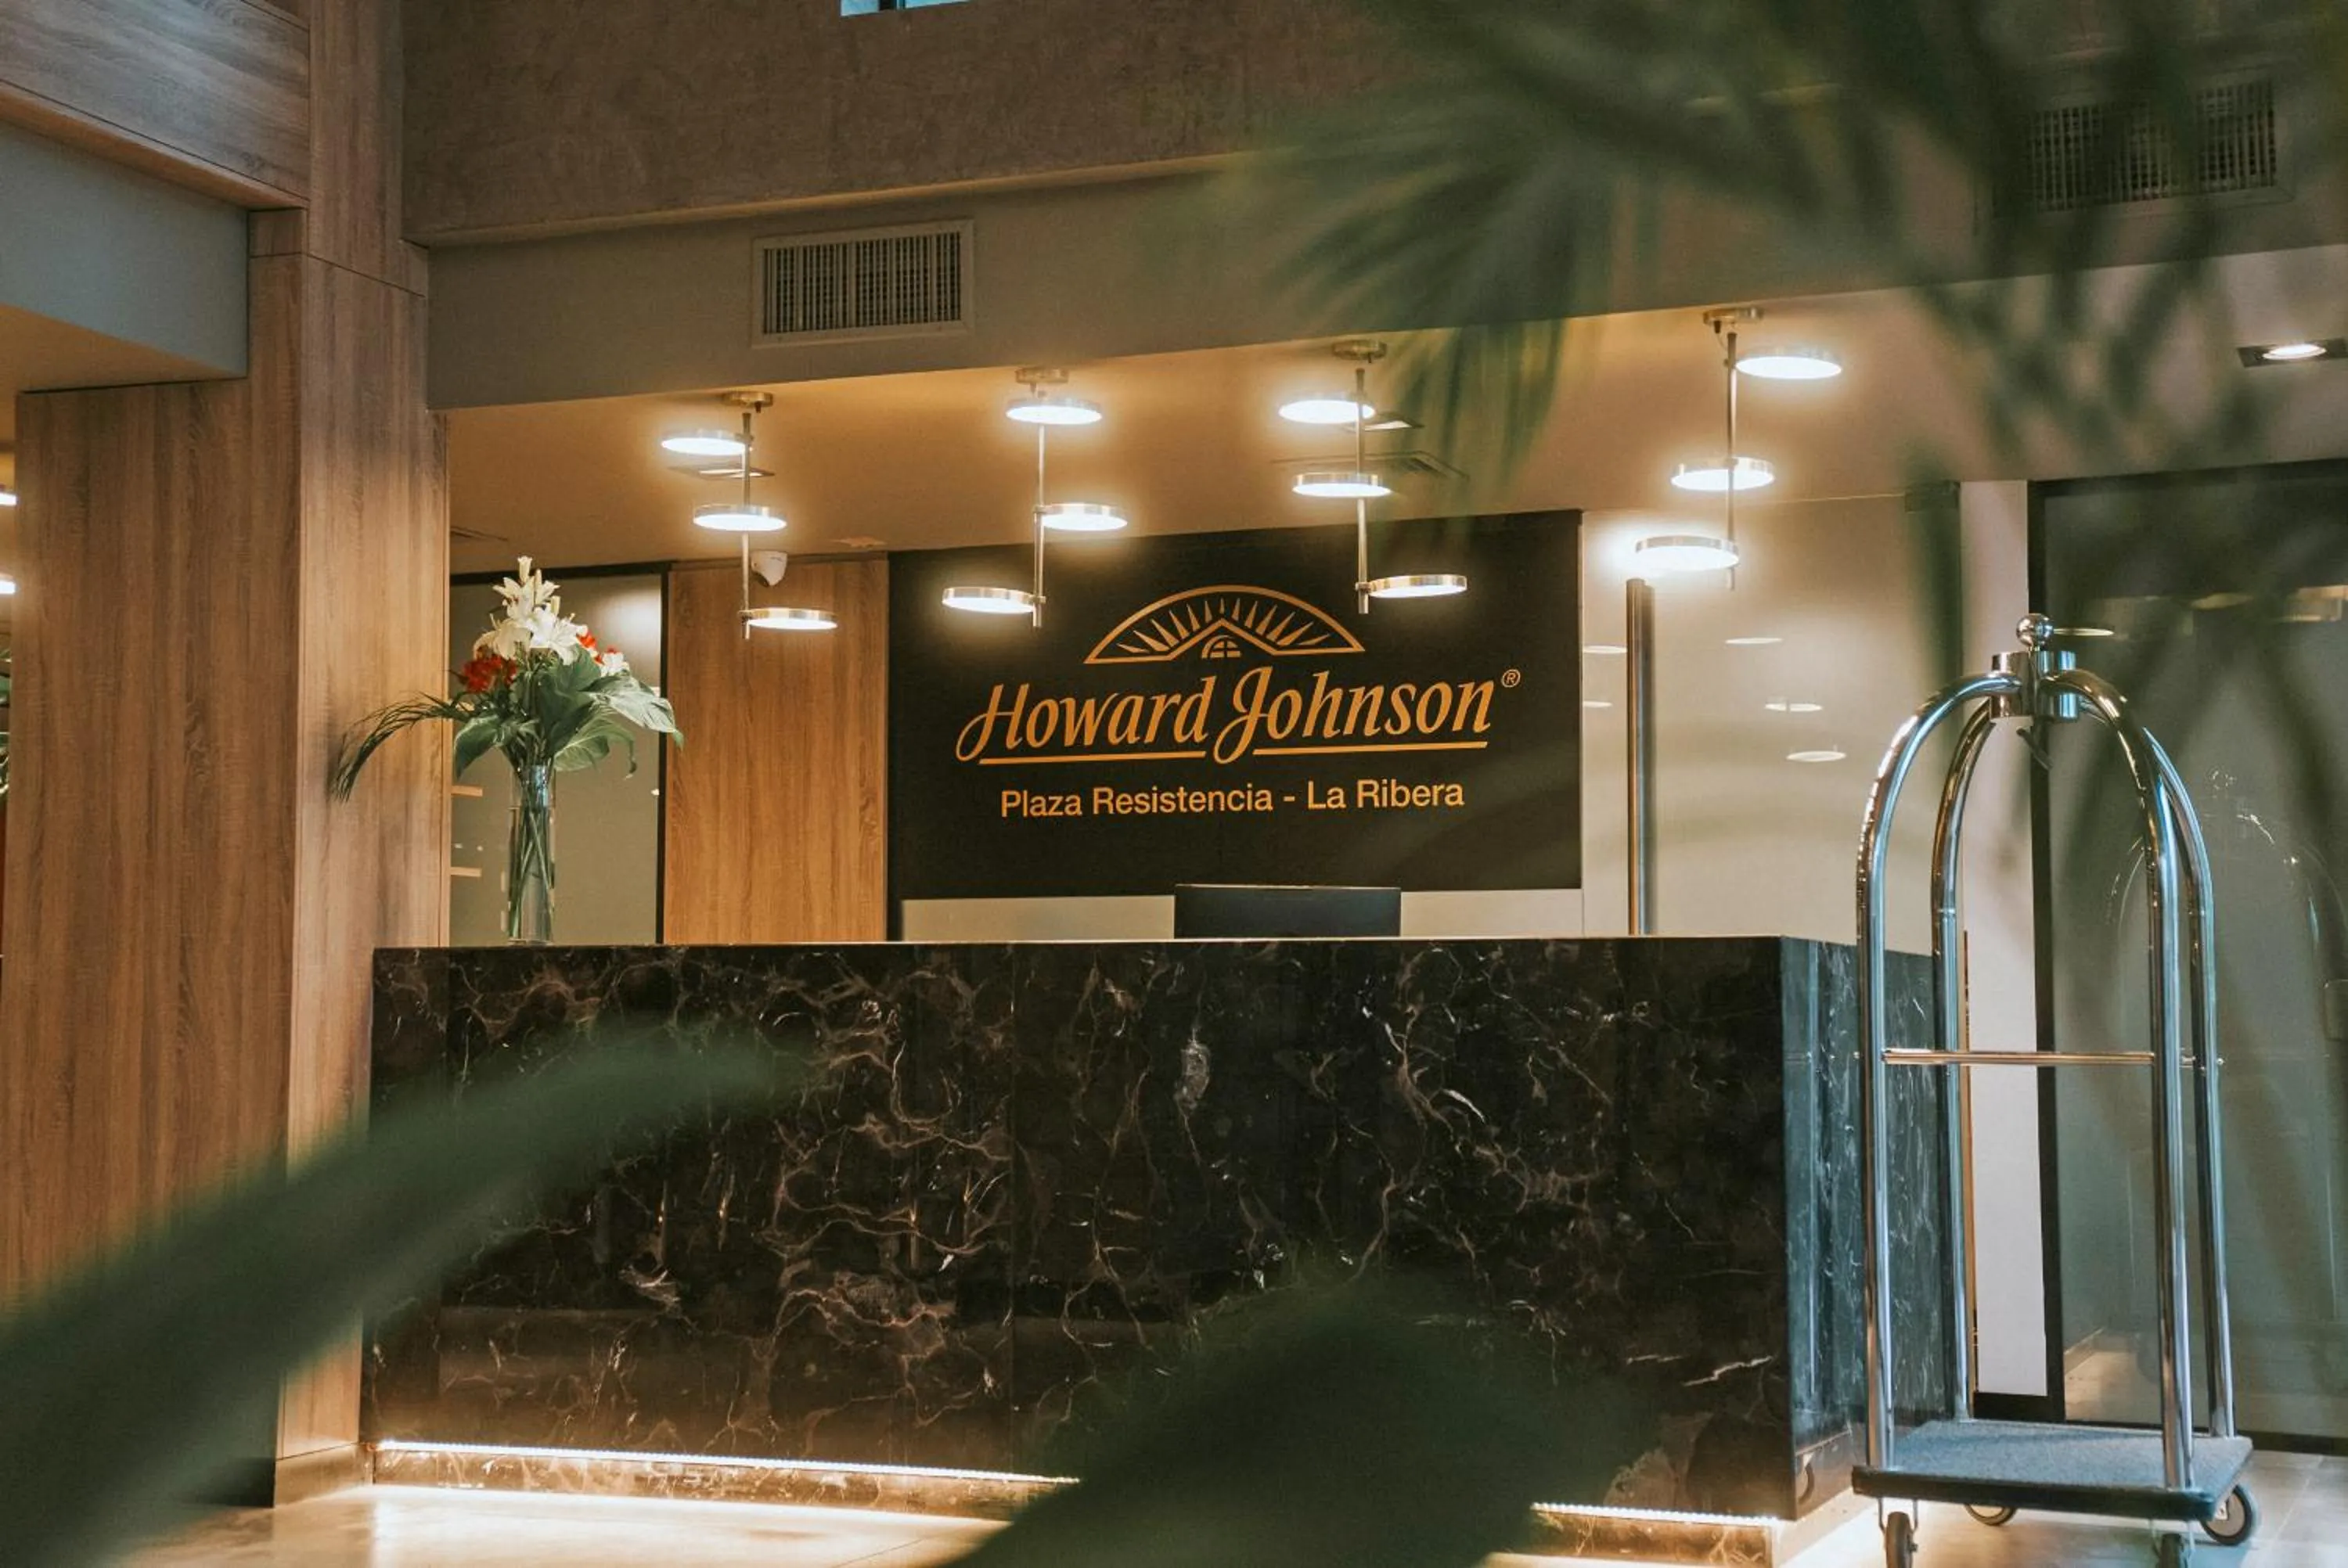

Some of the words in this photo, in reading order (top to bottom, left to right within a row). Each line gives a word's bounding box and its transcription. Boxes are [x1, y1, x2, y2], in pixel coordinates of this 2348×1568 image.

[955, 675, 1215, 762] Howard
[1000, 789, 1082, 818] Plaza
[1092, 782, 1276, 815] Resistencia
[1305, 777, 1348, 811] La
[1355, 776, 1466, 811] Ribera
